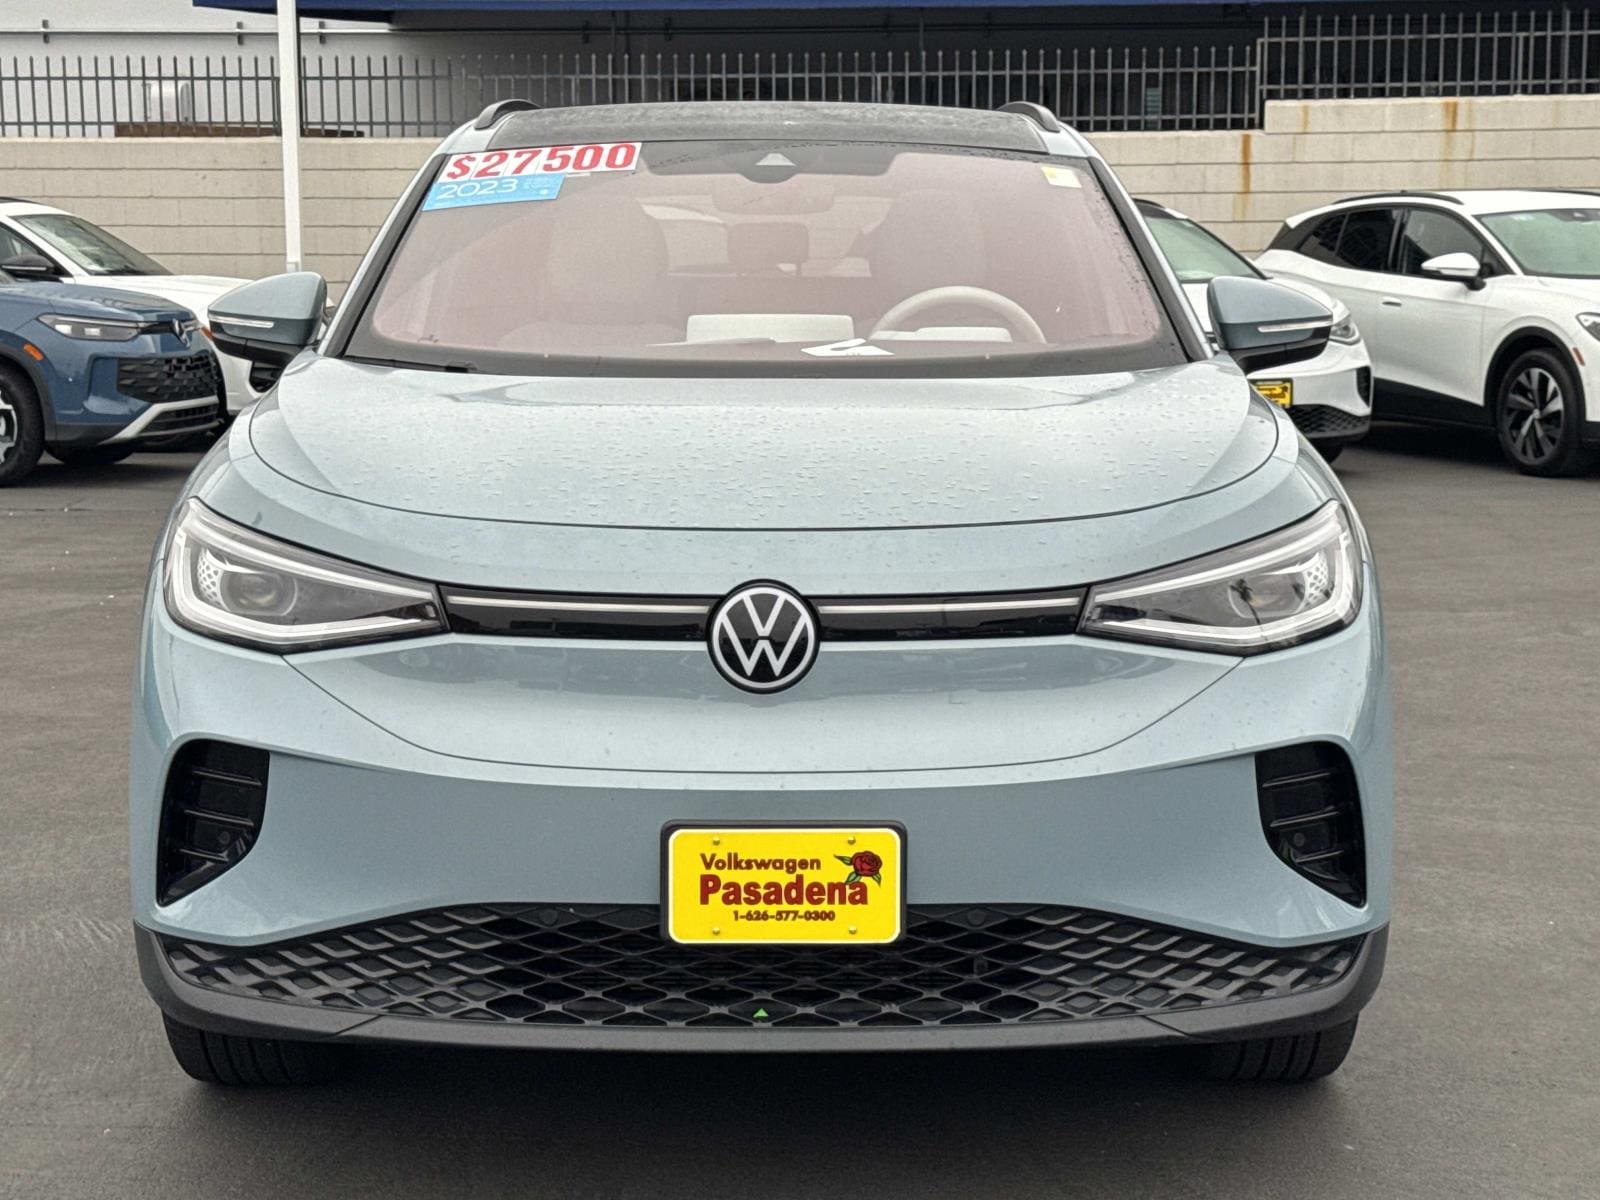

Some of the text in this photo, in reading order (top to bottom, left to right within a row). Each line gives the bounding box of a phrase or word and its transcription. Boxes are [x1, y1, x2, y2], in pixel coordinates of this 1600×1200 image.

[446, 143, 636, 180] $27500
[436, 178, 518, 200] 2023
[717, 588, 809, 679] VW
[700, 853, 821, 874] Volkswagen
[700, 874, 868, 905] Pasadena
[733, 910, 836, 922] 1-626-577-0300
